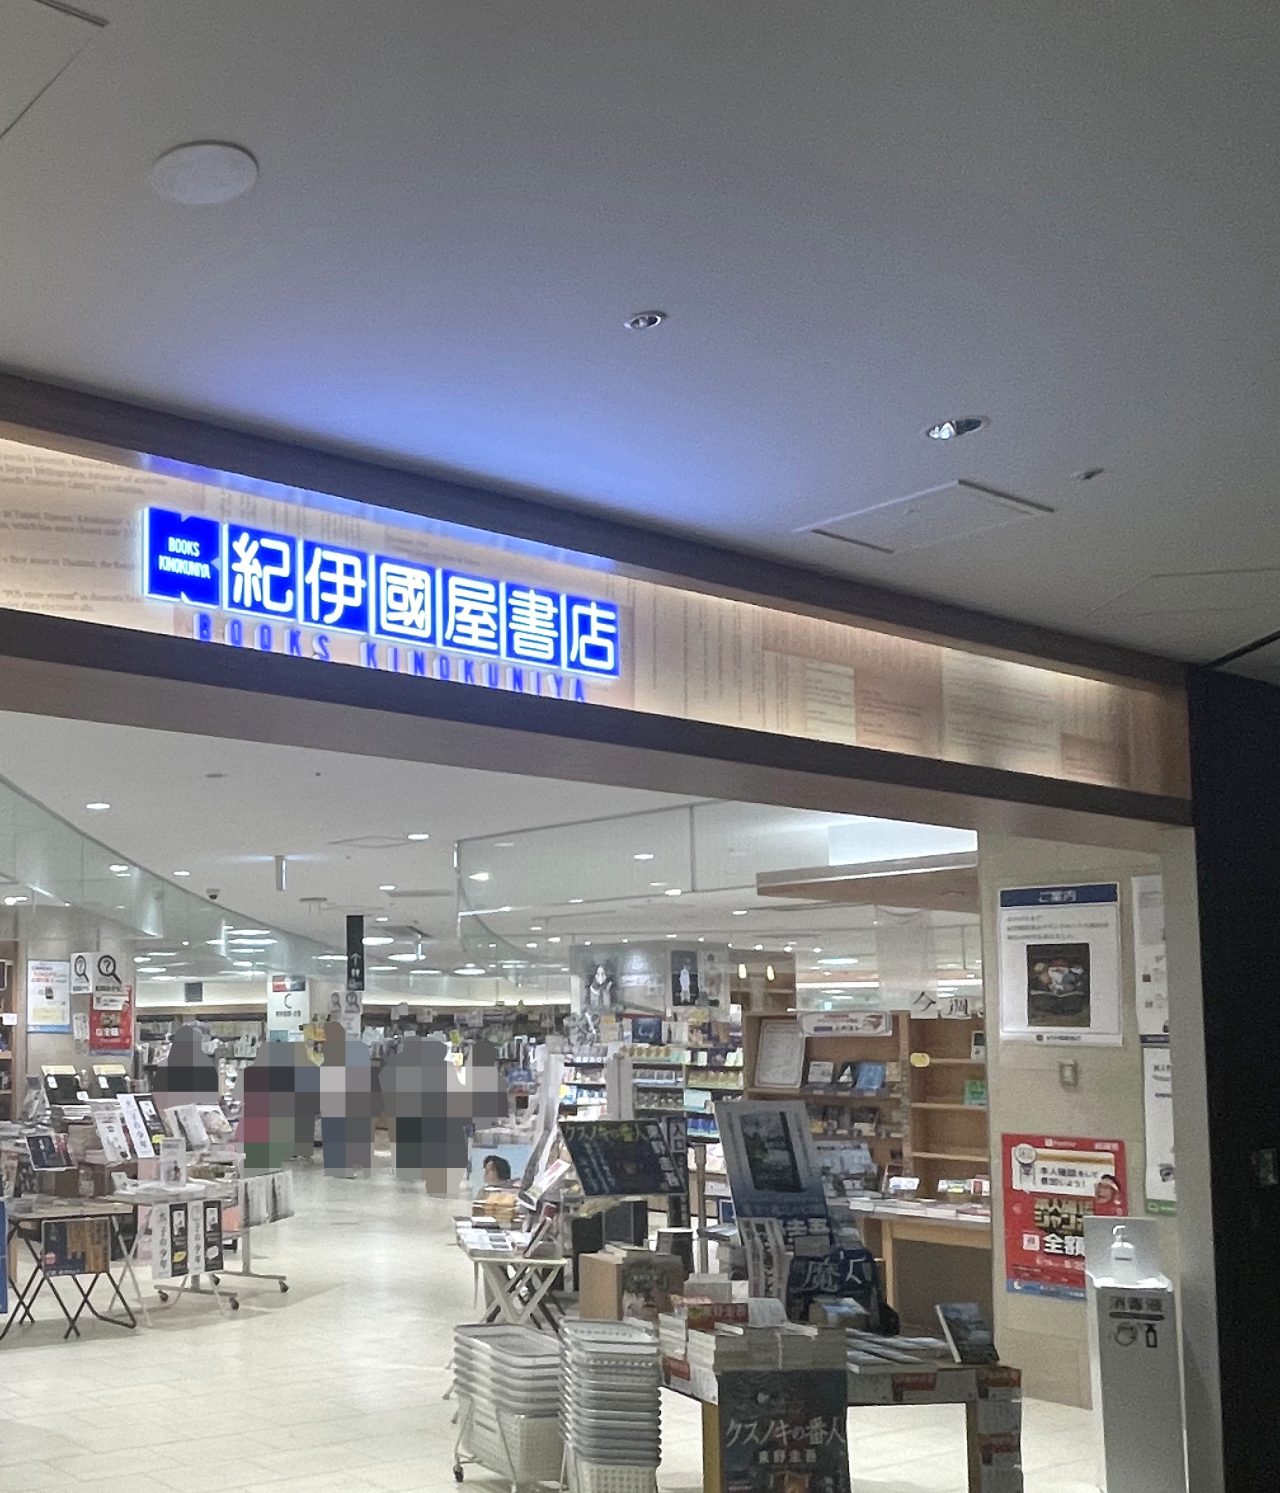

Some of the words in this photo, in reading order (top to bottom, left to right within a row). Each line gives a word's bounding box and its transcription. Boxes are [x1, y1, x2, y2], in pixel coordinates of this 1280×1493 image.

[168, 536, 200, 557] BOOKS
[159, 554, 211, 579] KINOKUNIYA
[231, 531, 617, 671] 紀伊國屋書店
[195, 611, 330, 662] BOOKS
[361, 638, 585, 702] KINOKUNIYA
[726, 1415, 846, 1448] クスノキの番人
